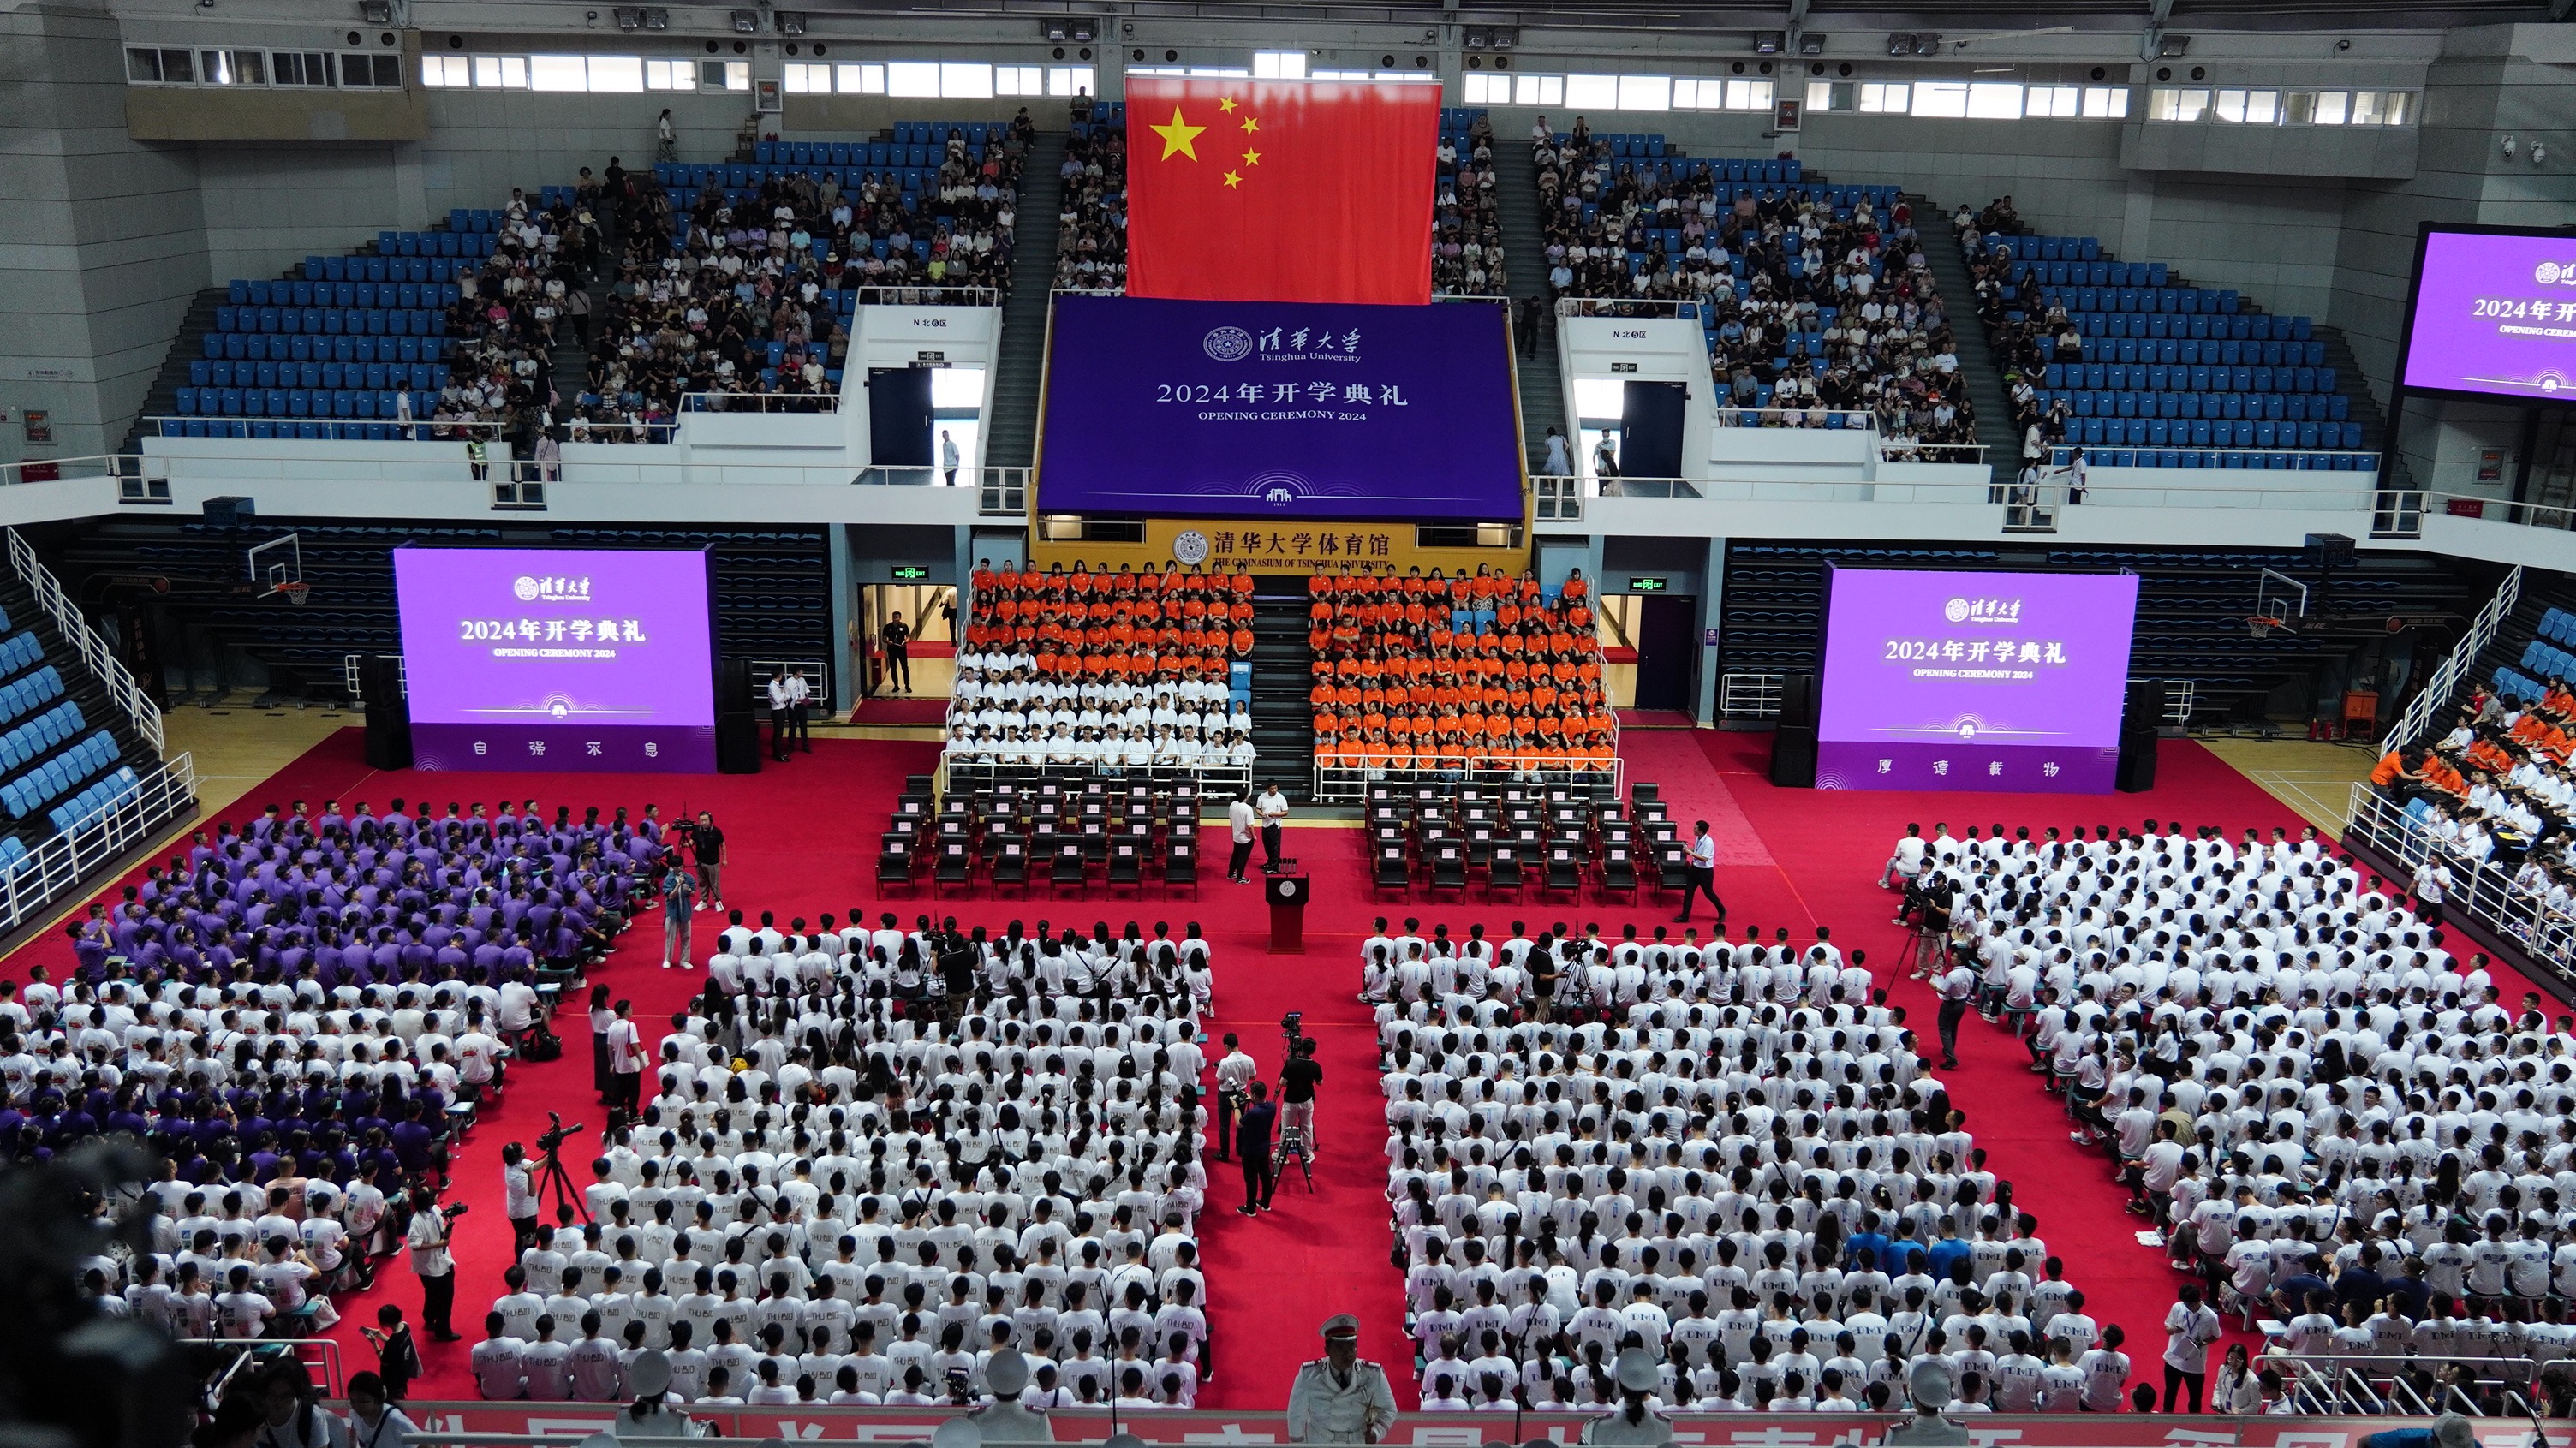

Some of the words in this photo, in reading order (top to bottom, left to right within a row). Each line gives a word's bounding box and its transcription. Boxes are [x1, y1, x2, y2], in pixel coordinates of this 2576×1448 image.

[2500, 325, 2543, 335] OPENING
[1260, 353, 1306, 361] Tsinghua
[1310, 353, 1361, 363] University
[1157, 381, 1408, 406] 2024年开学典礼
[1199, 411, 1258, 420] OPENING
[1261, 410, 1335, 420] CEREMONY
[1339, 412, 1366, 420] 2024
[1214, 531, 1390, 556] 清华大学体育馆
[1285, 559, 1295, 568] OF
[462, 619, 646, 641] 2024年开学典礼
[494, 648, 538, 658] OPENING
[539, 649, 593, 658] CEREMONY
[594, 649, 616, 658] 2024
[1885, 641, 2066, 664] 2024年开学典礼
[1913, 668, 1956, 678] OPENING
[1958, 669, 2011, 678] CEREMONY
[2012, 670, 2033, 679] 2024
